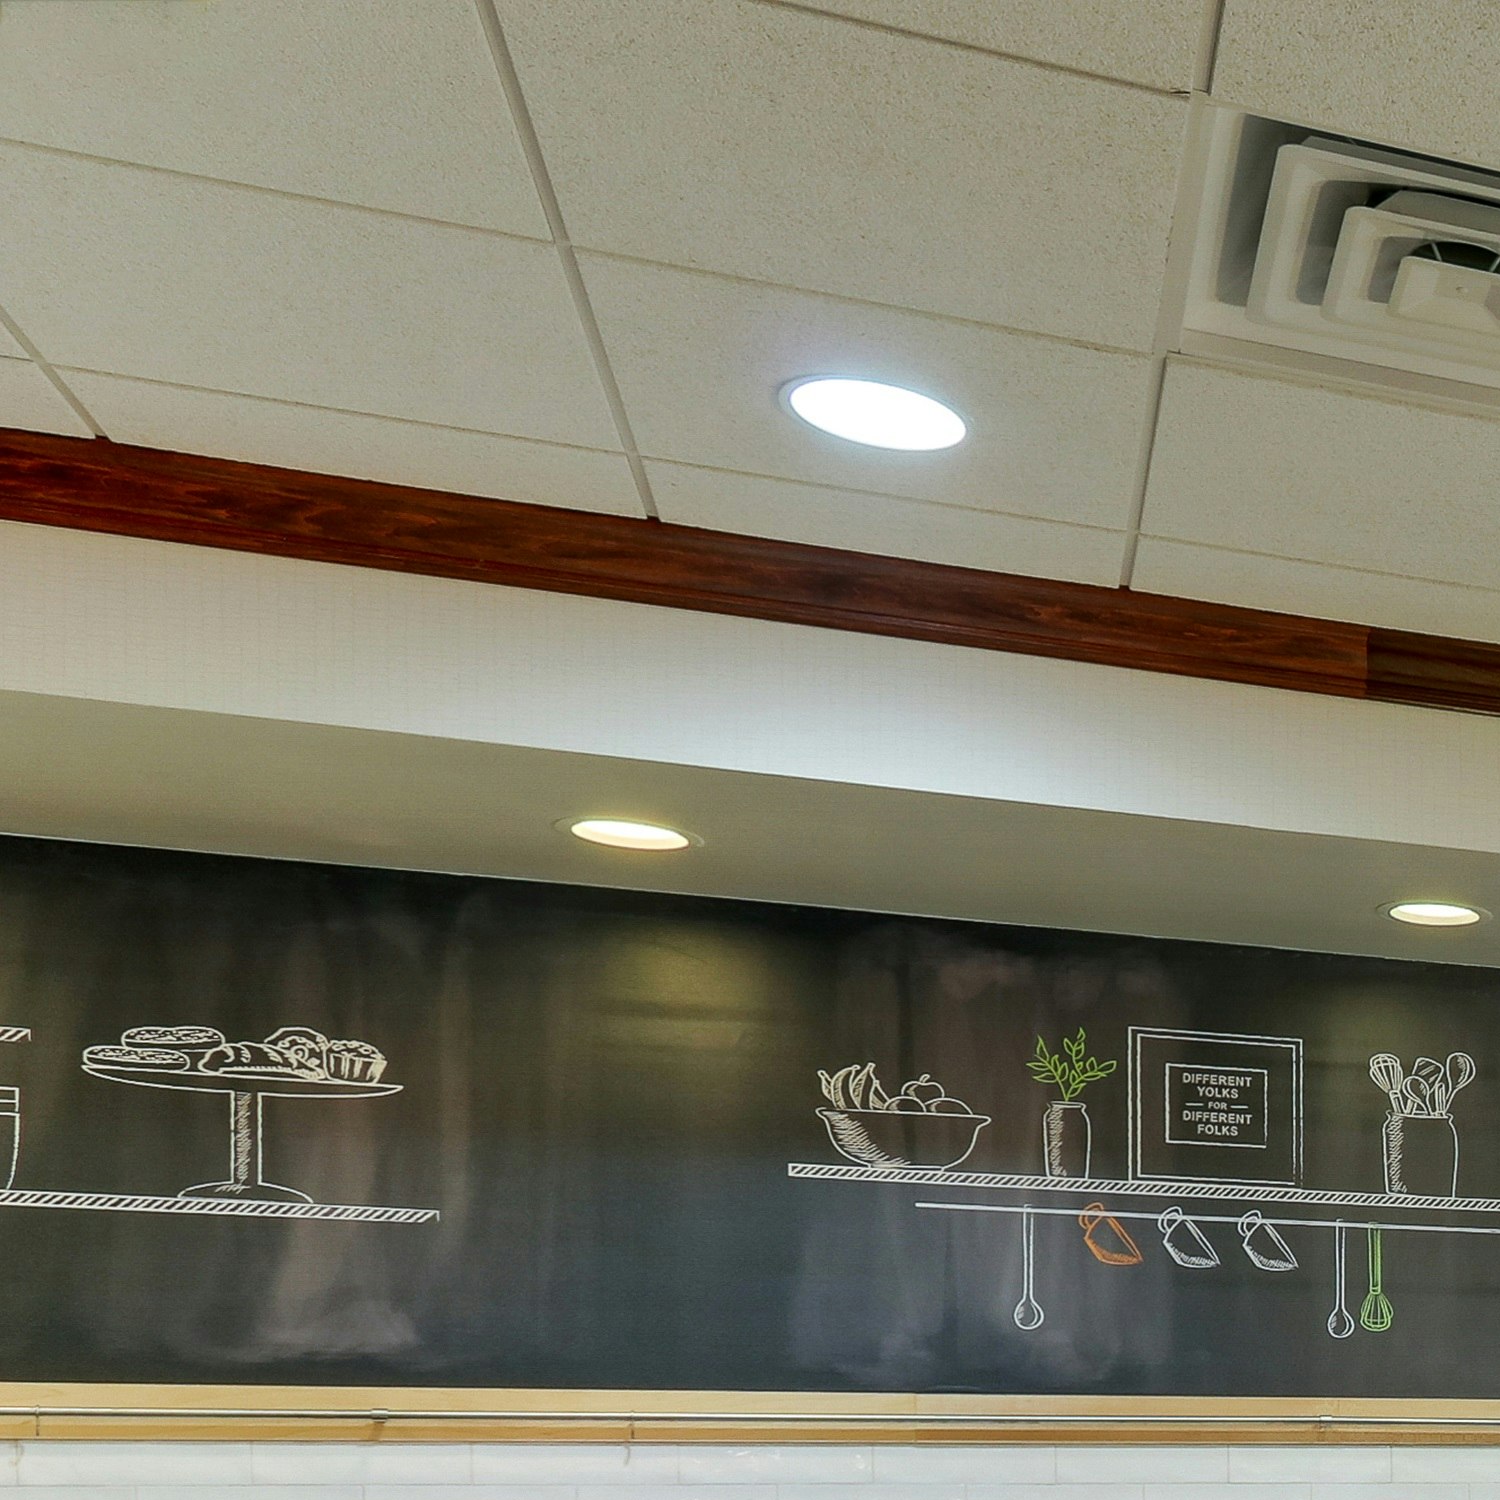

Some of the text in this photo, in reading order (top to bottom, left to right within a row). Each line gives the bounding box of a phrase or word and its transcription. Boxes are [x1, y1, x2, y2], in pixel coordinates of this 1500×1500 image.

[1182, 1073, 1252, 1087] DIFFERENT
[1197, 1086, 1239, 1099] YOLKS
[1208, 1101, 1227, 1110] FOR
[1182, 1110, 1253, 1124] DIFFERENT
[1197, 1124, 1239, 1136] FOLKS
